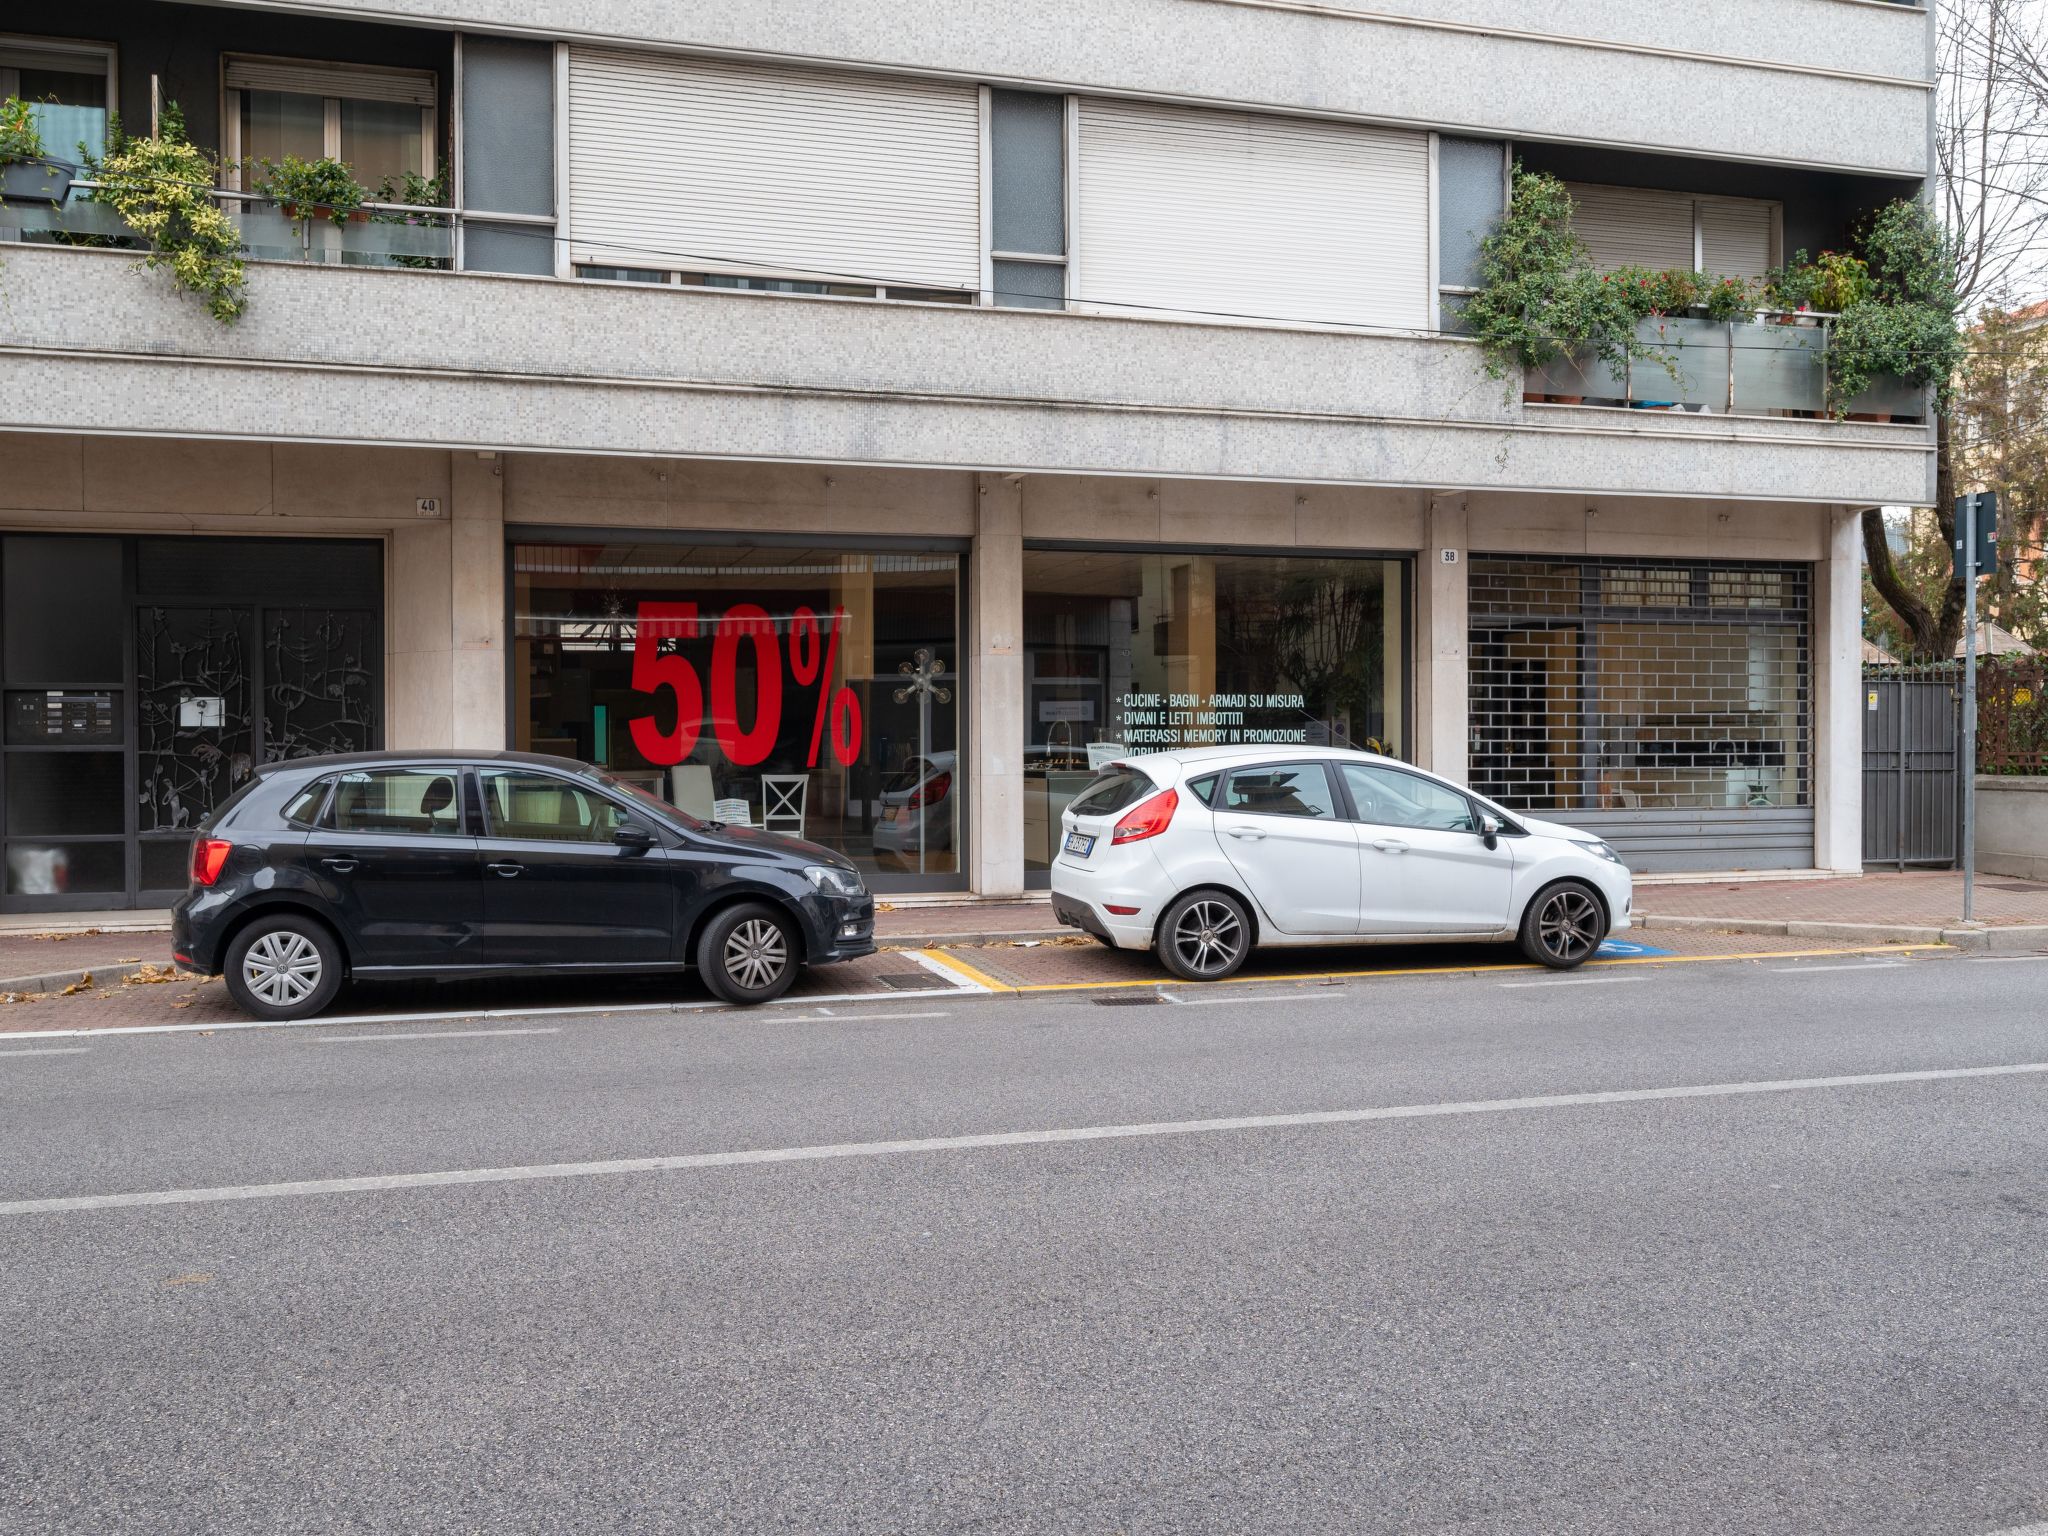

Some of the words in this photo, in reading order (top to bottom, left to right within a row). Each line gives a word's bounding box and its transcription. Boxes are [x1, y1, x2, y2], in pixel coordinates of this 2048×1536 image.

[421, 500, 435, 511] 40
[1444, 551, 1455, 561] 38
[628, 601, 862, 767] 50%
[1123, 693, 1160, 707] CUCINE
[1169, 693, 1199, 707] BAGNI
[1208, 694, 1246, 708] ARMADI
[1249, 694, 1263, 708] SU
[1266, 694, 1305, 708] MISURA
[1124, 711, 1156, 725] DIVANI
[1160, 711, 1166, 725] E
[1169, 711, 1193, 725] LETTI
[1196, 711, 1243, 725] IMBOTTITI
[1123, 729, 1180, 743] MATERASSI
[1184, 729, 1228, 743] MEMORY
[1230, 729, 1240, 743] IN
[1243, 729, 1307, 743] PROMOZIONE
